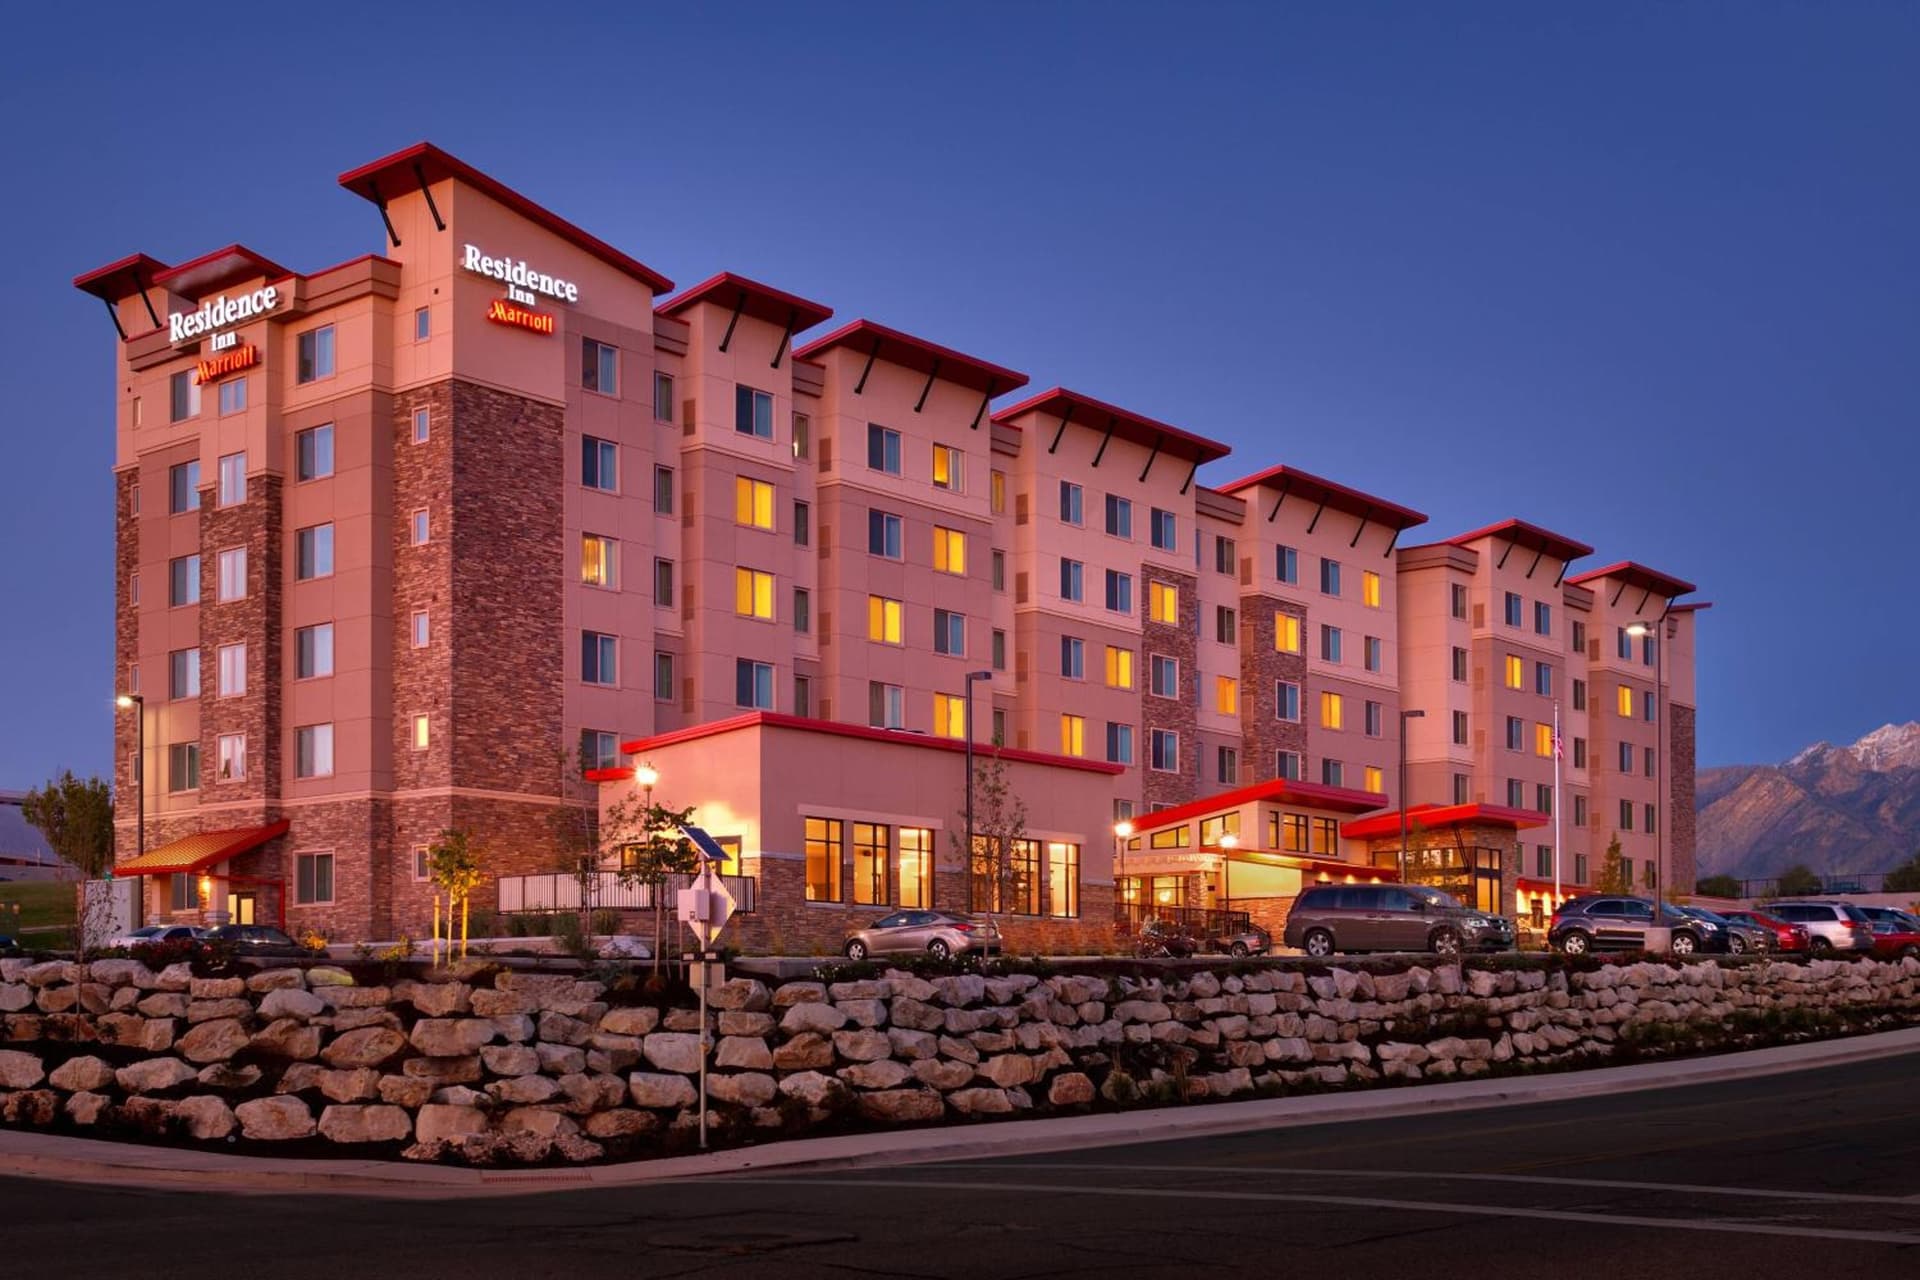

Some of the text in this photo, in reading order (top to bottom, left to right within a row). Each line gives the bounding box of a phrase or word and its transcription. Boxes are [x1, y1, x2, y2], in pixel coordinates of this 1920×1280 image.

[463, 243, 578, 302] Residence
[508, 284, 536, 306] Inn
[169, 285, 277, 343] Residence
[488, 301, 553, 333] Marriott
[210, 331, 237, 352] Inn
[194, 345, 255, 386] Marriott
